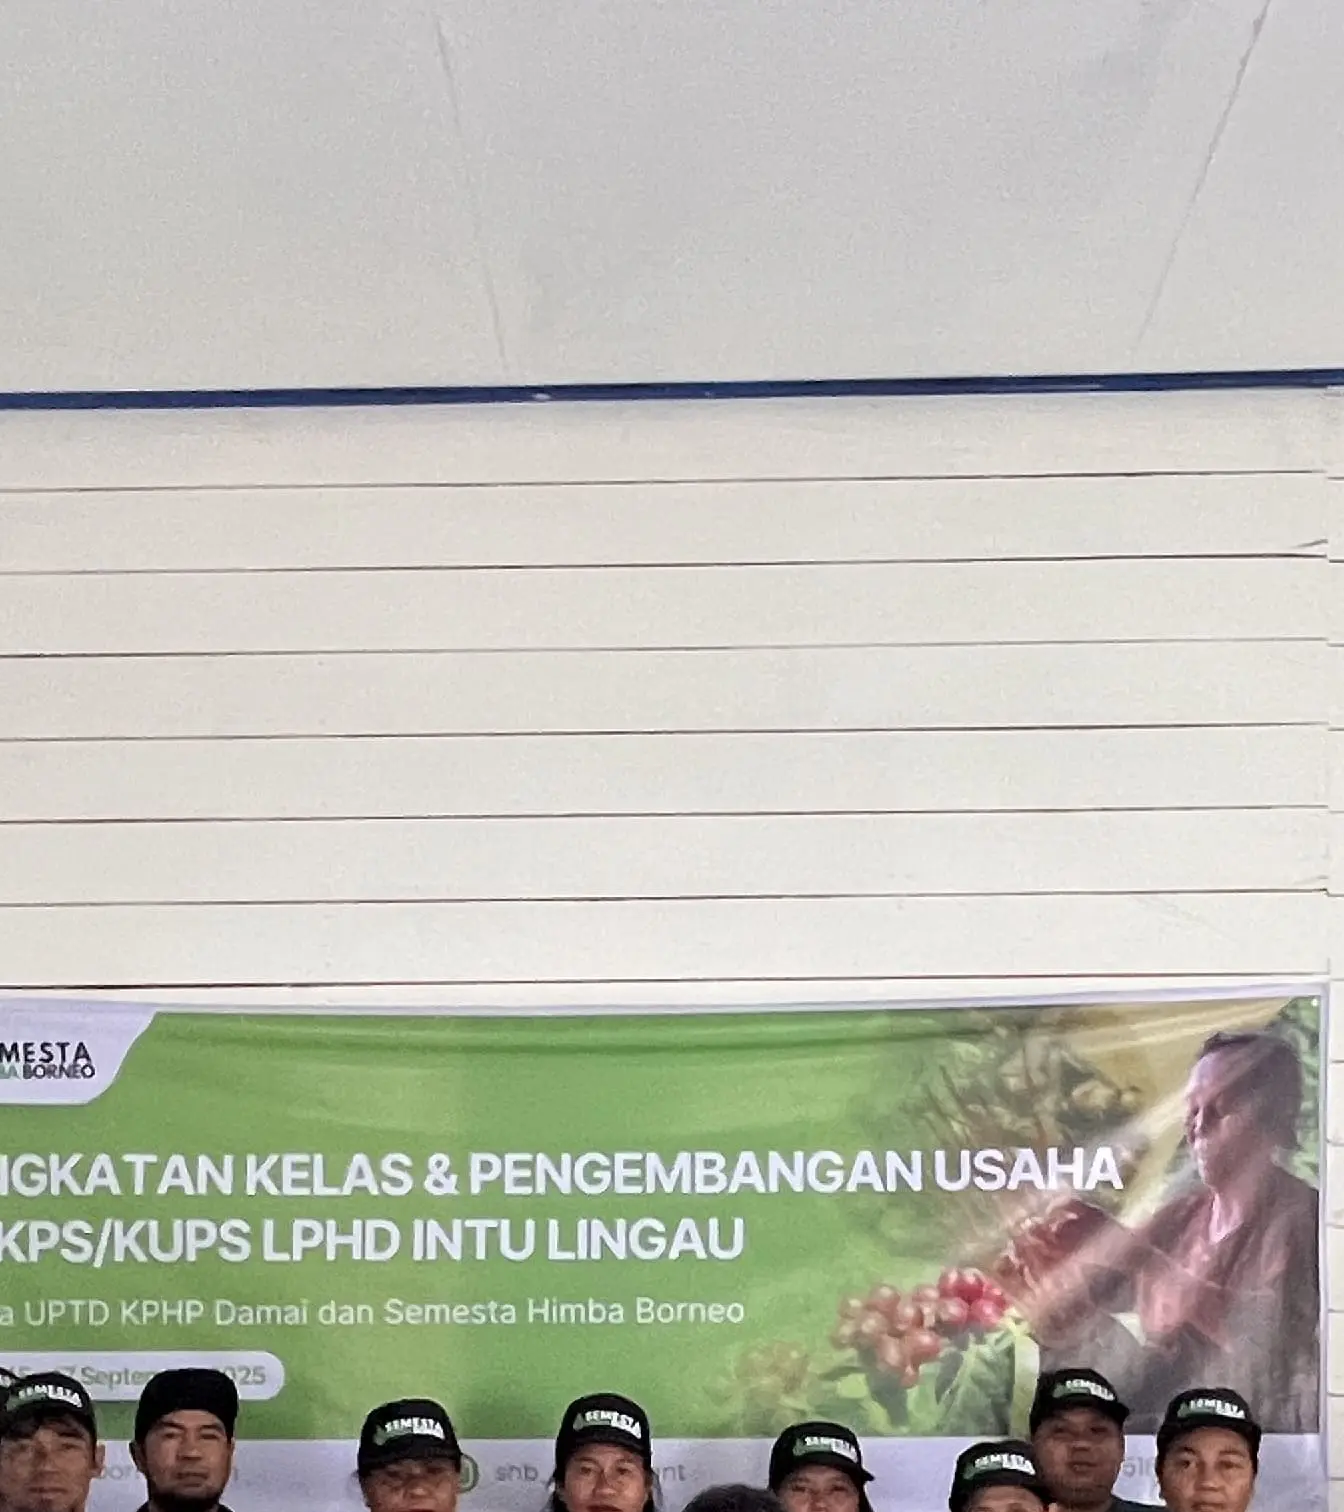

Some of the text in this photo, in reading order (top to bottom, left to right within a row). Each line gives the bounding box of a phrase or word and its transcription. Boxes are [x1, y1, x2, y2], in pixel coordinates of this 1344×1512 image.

[22, 1063, 96, 1080] BORNEO
[246, 1152, 413, 1196] KELAS
[424, 1152, 459, 1196] &
[470, 1150, 922, 1195] PENGEMBANGAN
[934, 1146, 1124, 1191] USAHA
[263, 1218, 401, 1262] LPHD
[413, 1218, 535, 1261] INTU
[548, 1217, 745, 1260] LINGAU
[25, 1300, 109, 1327] UPTD
[120, 1299, 204, 1326] KPHP
[214, 1299, 309, 1326] Damai
[318, 1299, 374, 1325] dan
[383, 1298, 517, 1324] Semesta
[528, 1297, 625, 1324] Himba
[636, 1297, 745, 1323] Borneo
